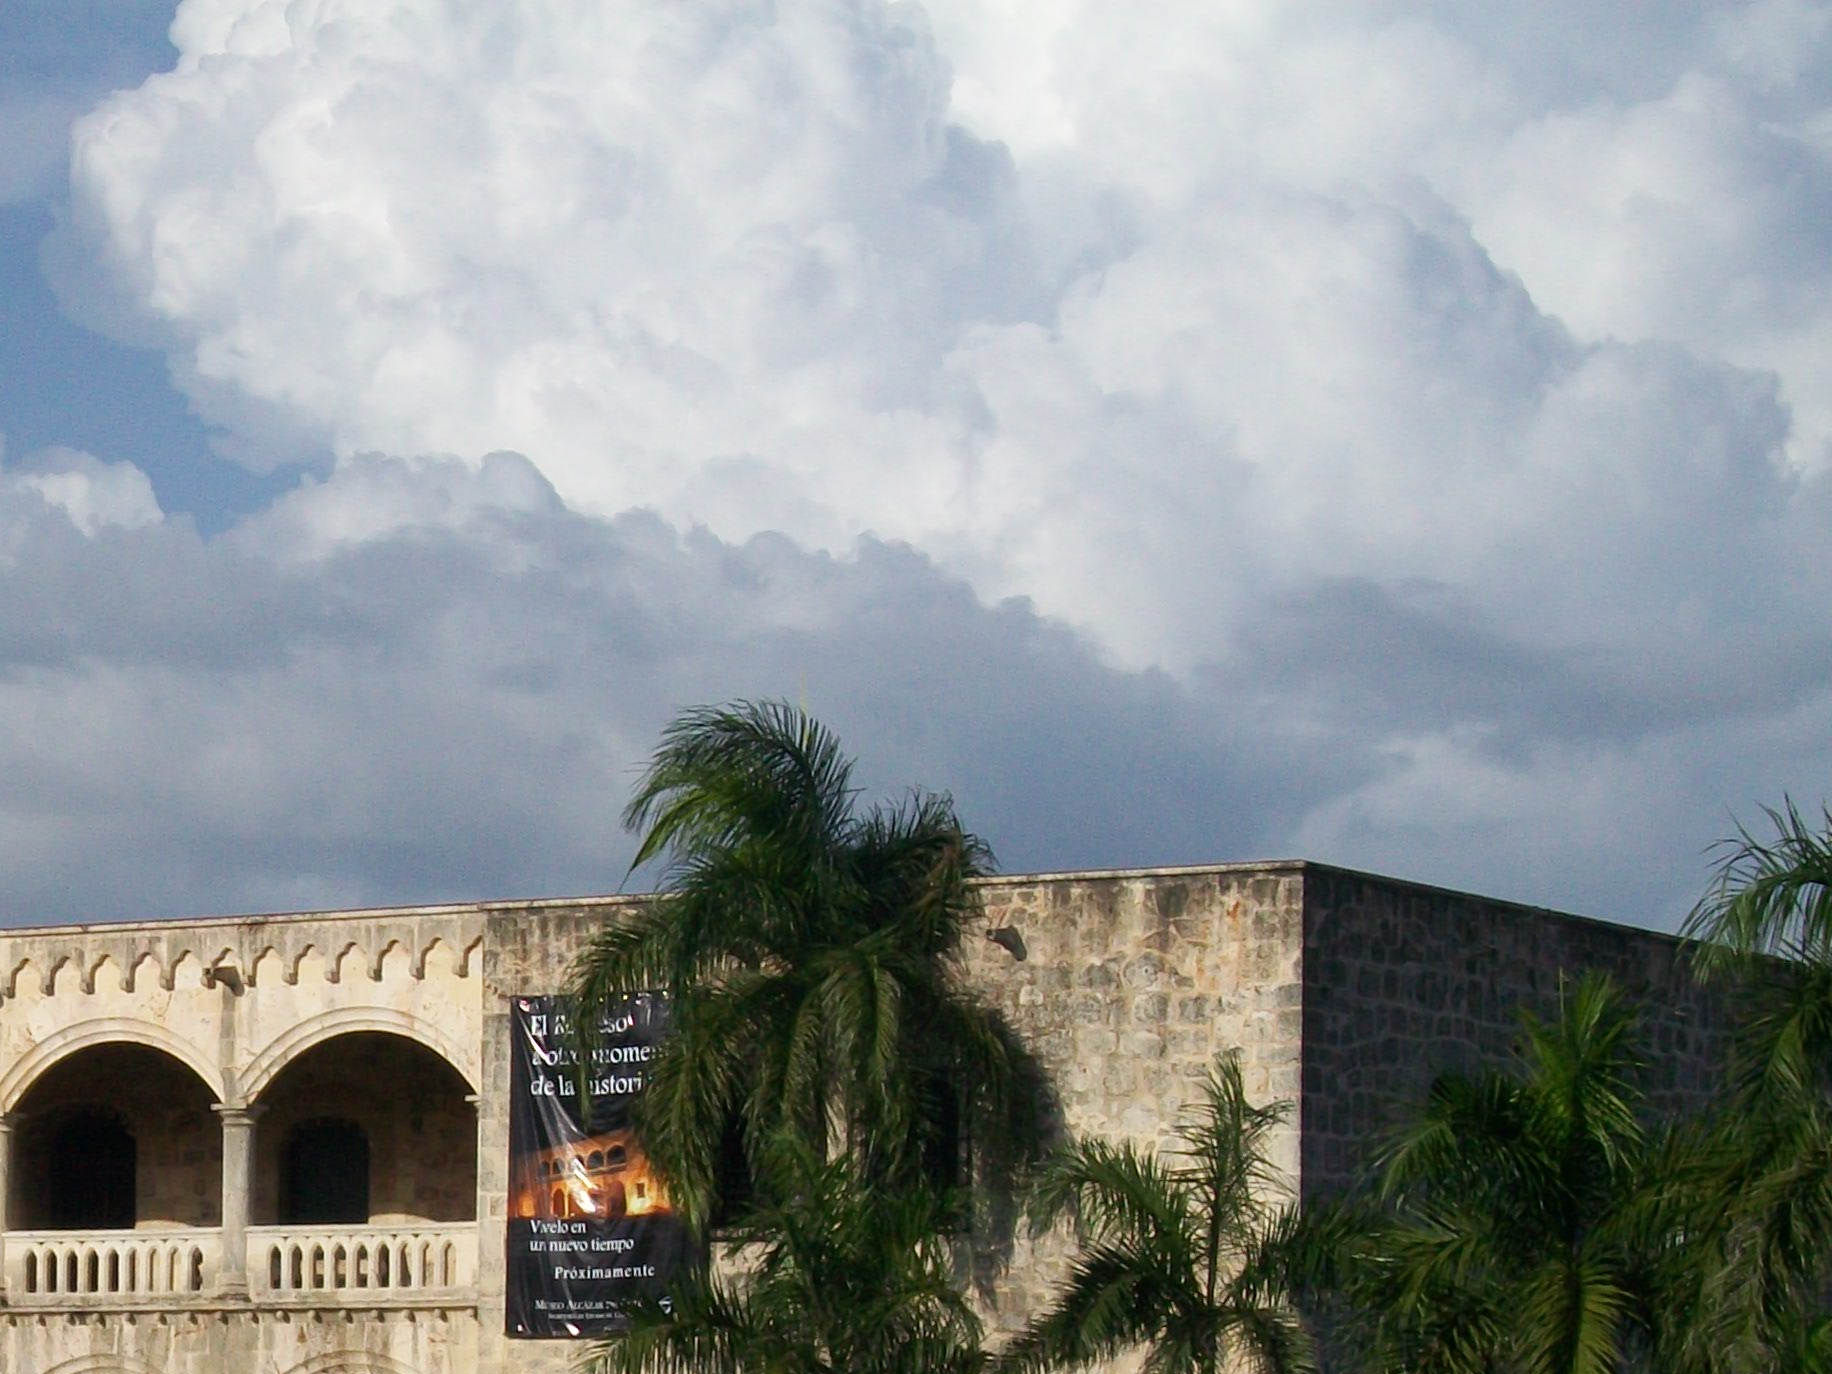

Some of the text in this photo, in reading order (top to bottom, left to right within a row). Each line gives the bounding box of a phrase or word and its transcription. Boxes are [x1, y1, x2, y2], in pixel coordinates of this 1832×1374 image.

[530, 1014, 548, 1037] El
[530, 1074, 555, 1096] de
[558, 1074, 576, 1096] la
[571, 1221, 587, 1234] en
[529, 1237, 635, 1254] un nuevo tiempo
[554, 1263, 656, 1280] Próximamente
